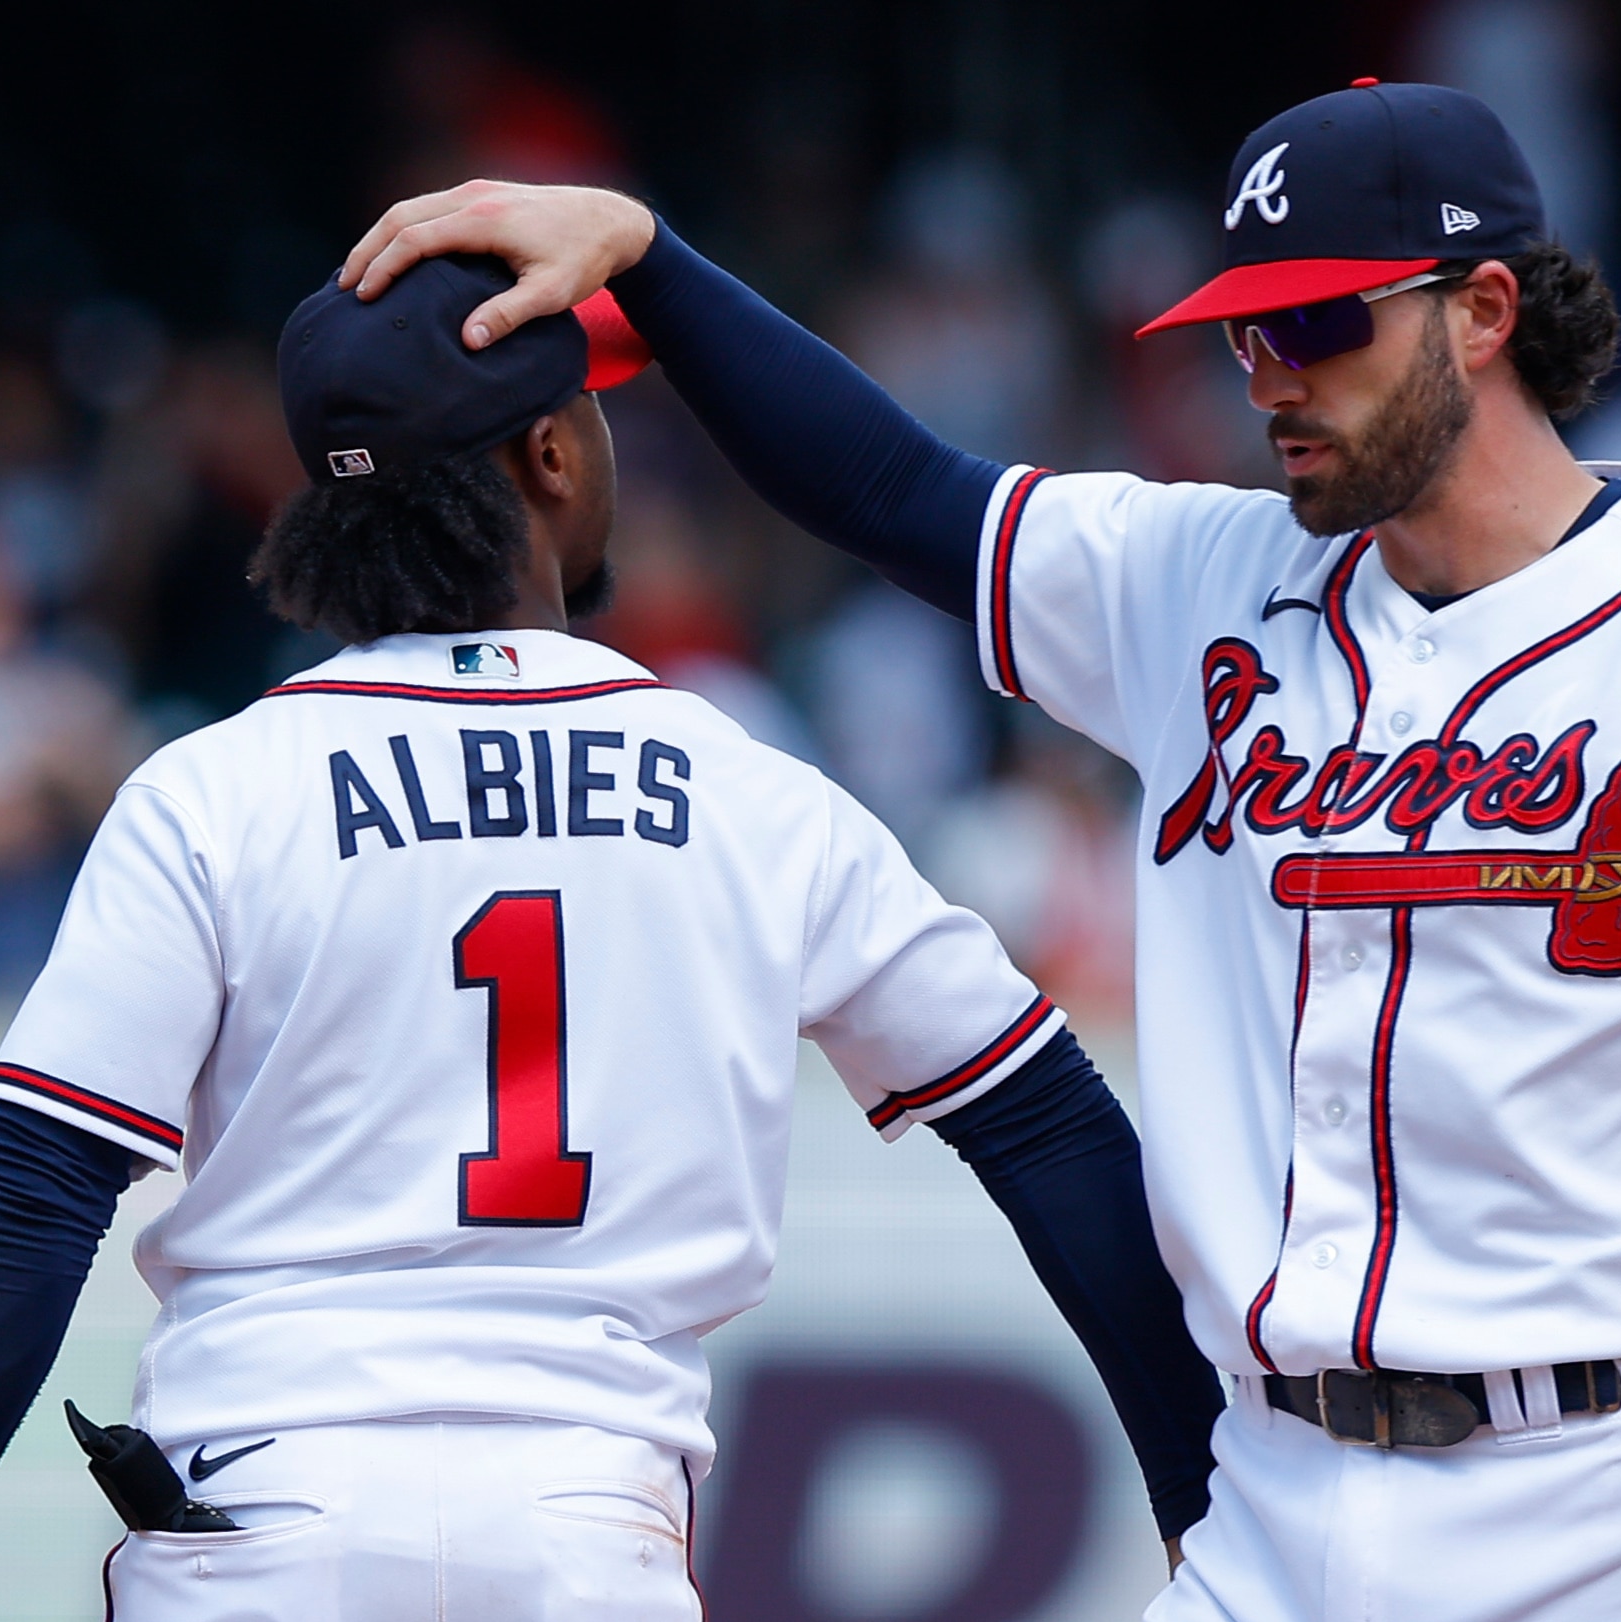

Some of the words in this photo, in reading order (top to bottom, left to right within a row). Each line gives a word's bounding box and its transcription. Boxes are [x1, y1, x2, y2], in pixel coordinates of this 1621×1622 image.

[328, 729, 691, 861] ALBIES
[1154, 636, 1596, 865] Braves
[451, 889, 594, 1228] 1
